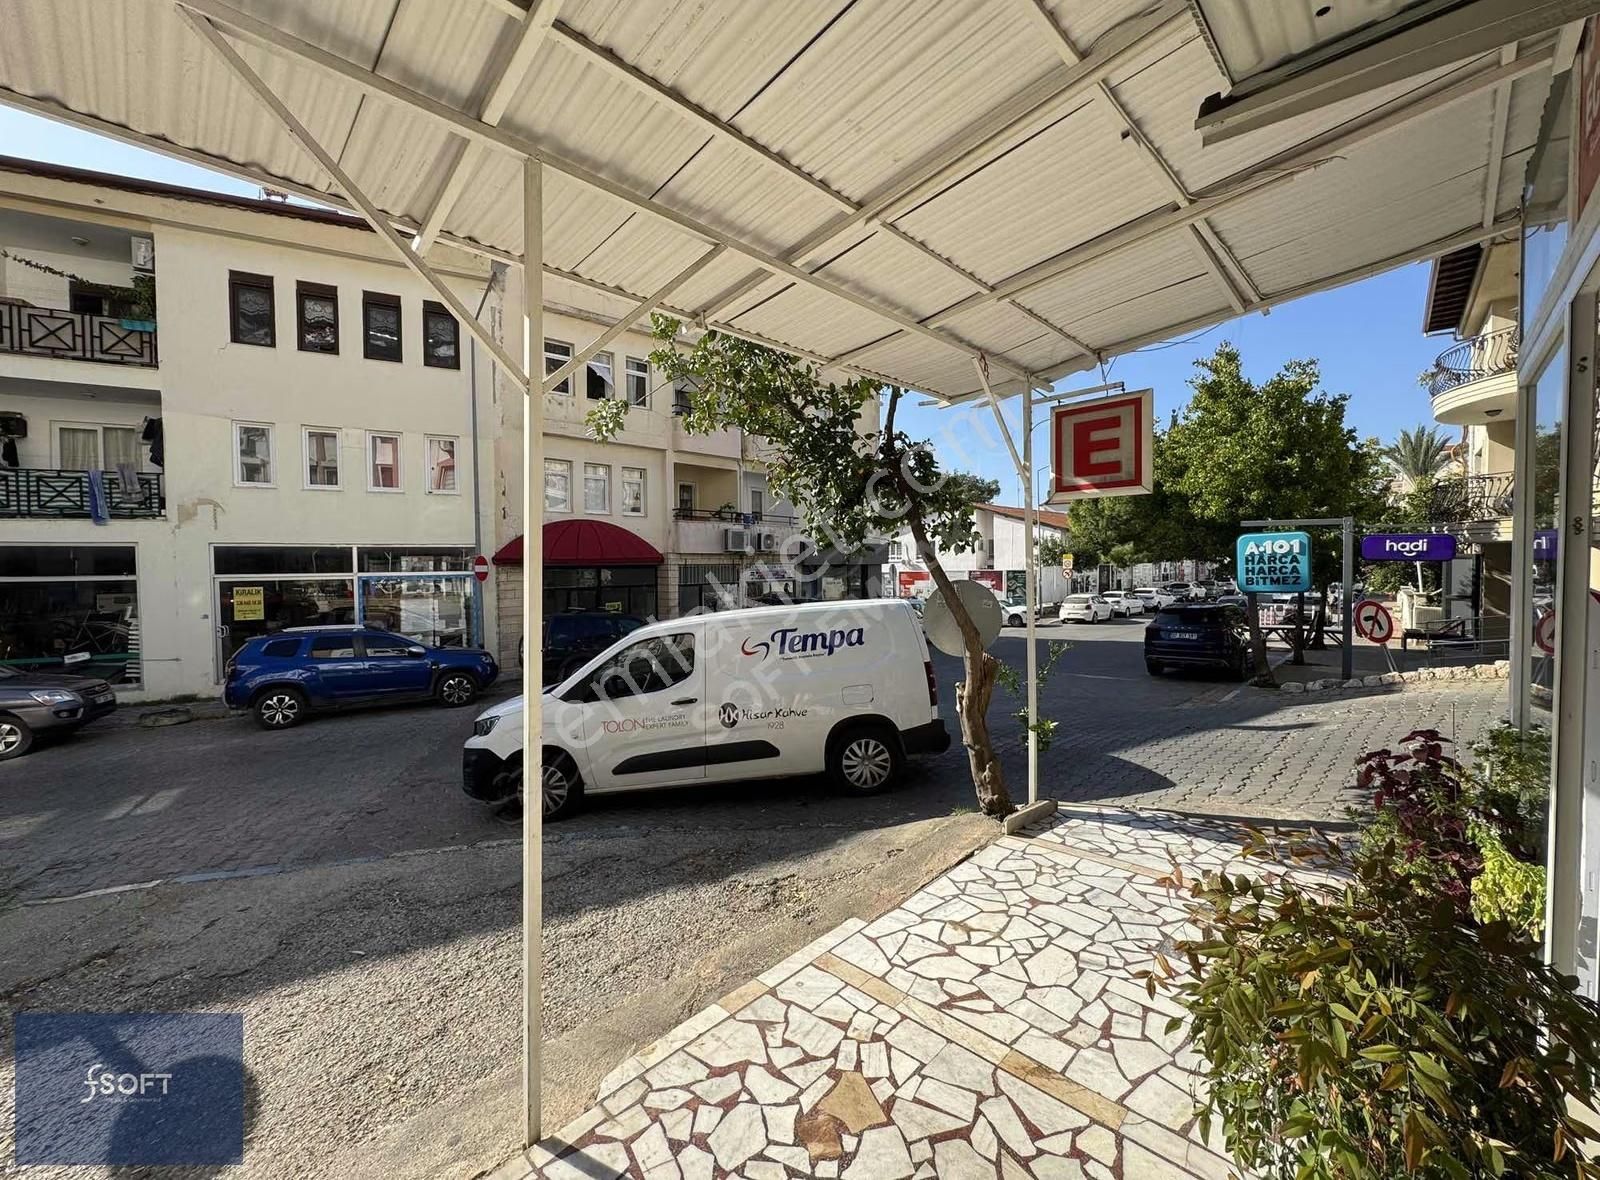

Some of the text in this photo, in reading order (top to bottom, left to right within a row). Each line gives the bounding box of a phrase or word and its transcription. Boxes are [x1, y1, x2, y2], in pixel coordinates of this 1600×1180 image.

[1074, 415, 1122, 477] E
[1386, 539, 1428, 553] hadi
[1245, 555, 1301, 565] HARCA
[1245, 565, 1301, 575] HARCA
[771, 627, 864, 656] Tempa
[742, 707, 808, 720] Hisar Kahve
[601, 717, 646, 734] TOLON
[767, 720, 785, 730] 1928
